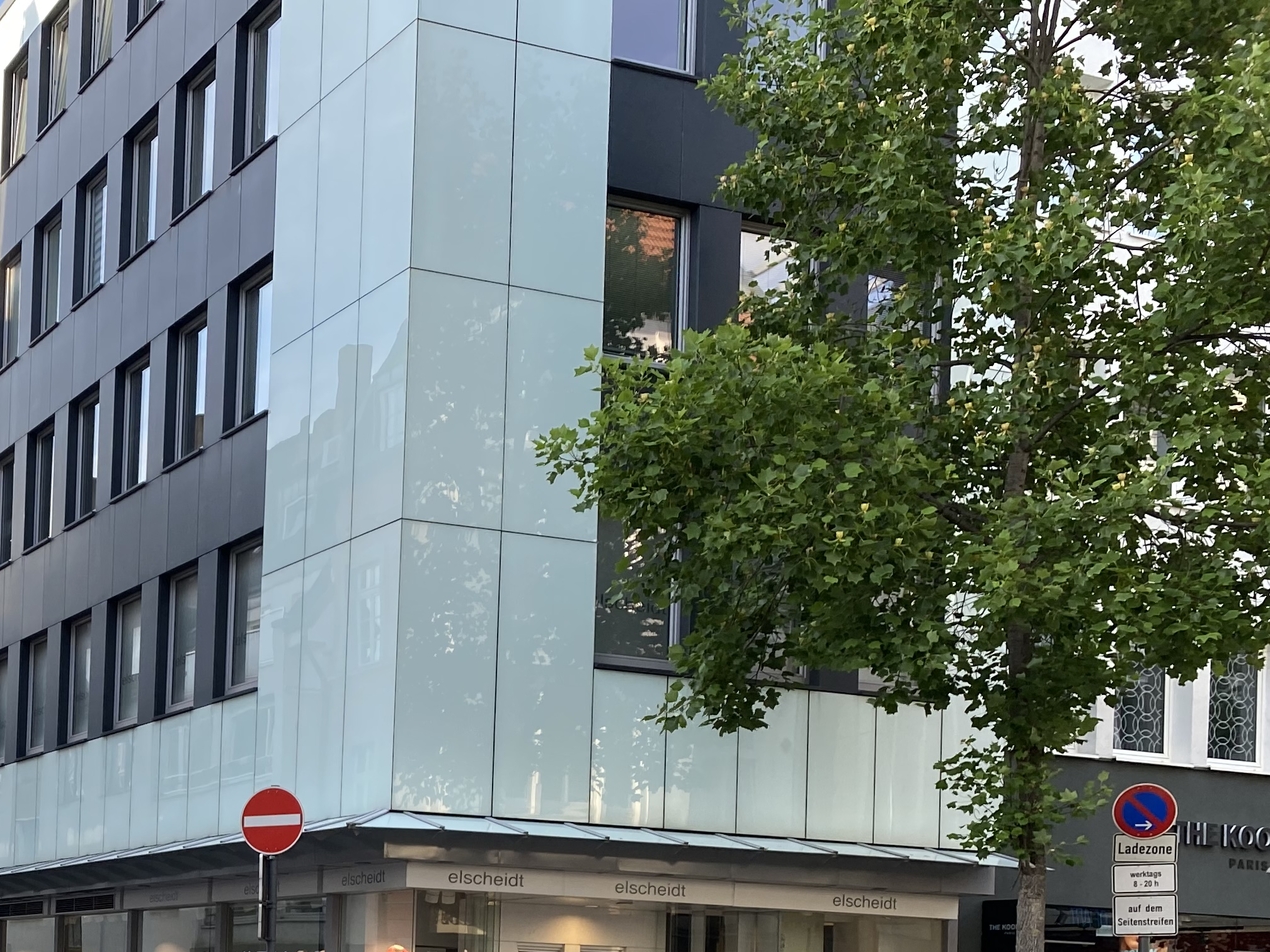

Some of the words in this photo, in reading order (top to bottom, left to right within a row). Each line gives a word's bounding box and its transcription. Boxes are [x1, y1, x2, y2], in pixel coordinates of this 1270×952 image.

[1168, 820, 1219, 846] THE
[1118, 842, 1173, 855] Ladezone
[1228, 858, 1270, 872] PARIS
[342, 870, 386, 886] elscheidt
[448, 869, 525, 888] elscheidt
[1129, 870, 1162, 878] werktags
[615, 881, 686, 897] elscheidt
[833, 894, 897, 910] elscheidt
[1128, 904, 1141, 913] auf
[1145, 904, 1163, 913] dem
[1001, 923, 1017, 931] KOO
[1117, 917, 1174, 926] Seitenstreifen
